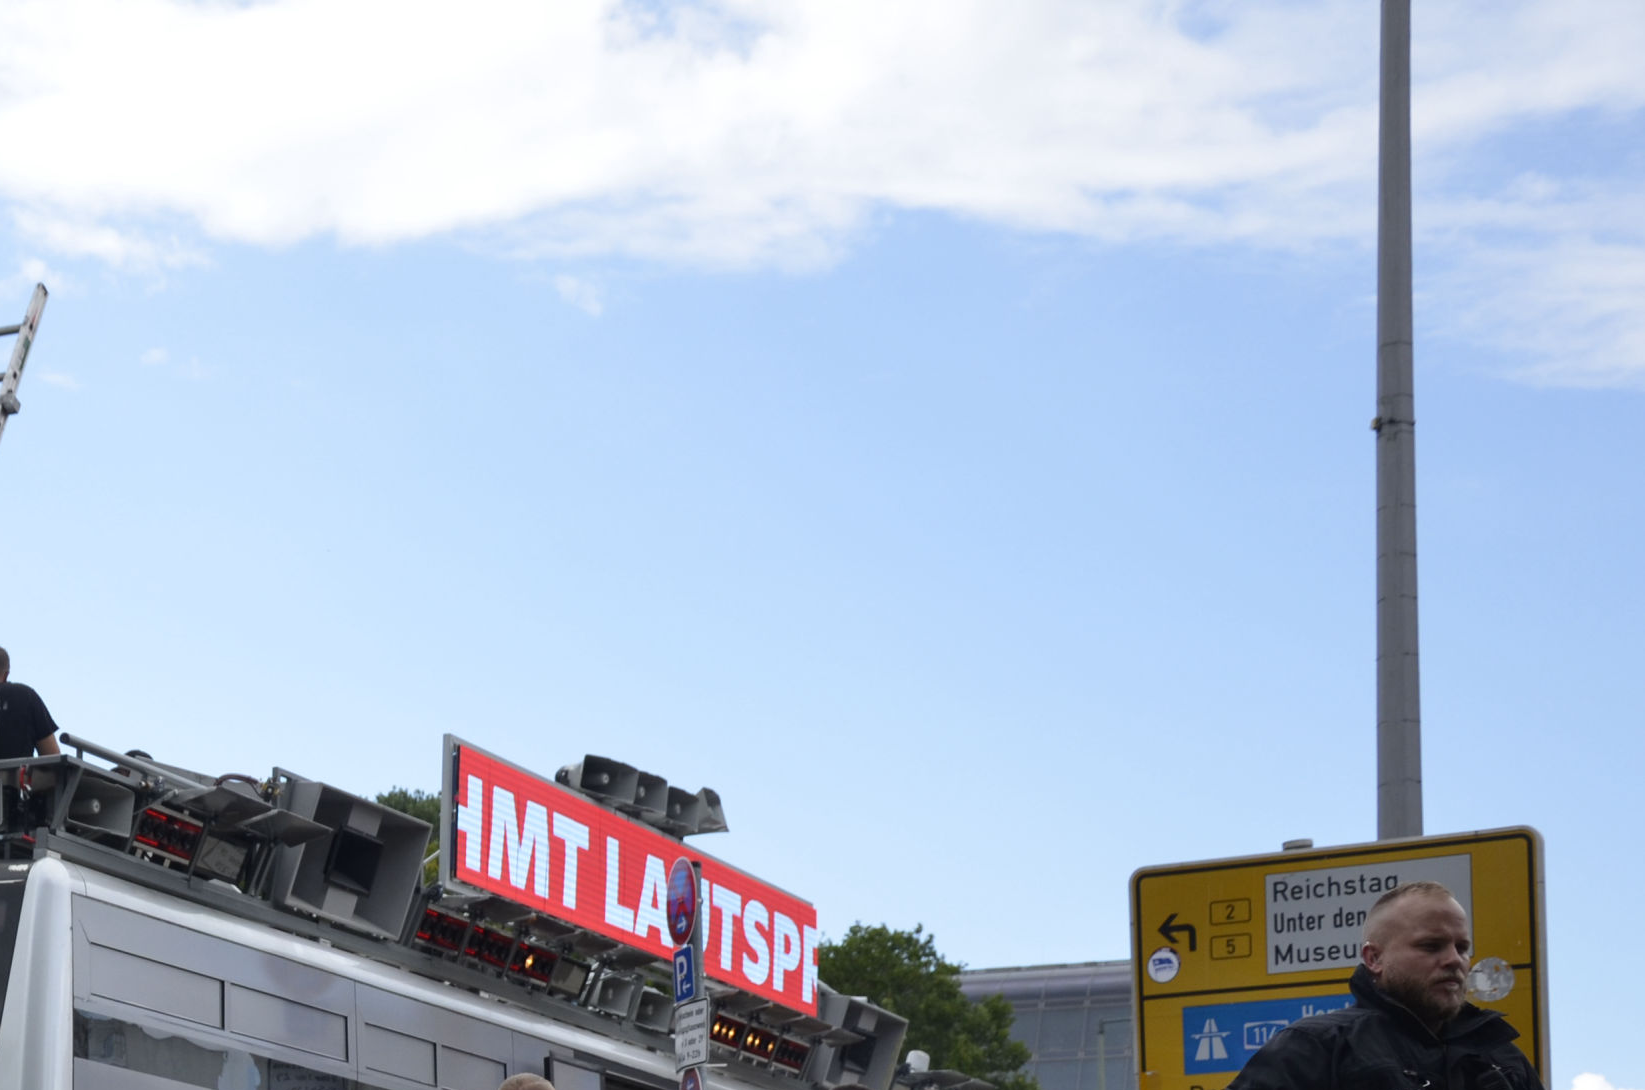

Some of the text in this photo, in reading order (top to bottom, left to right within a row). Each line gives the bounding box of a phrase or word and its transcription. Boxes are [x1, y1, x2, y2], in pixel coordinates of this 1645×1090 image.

[1225, 904, 1235, 920] 2
[1274, 906, 1366, 934] Unter den
[1226, 938, 1236, 955] 5
[1275, 943, 1363, 966] Museu
